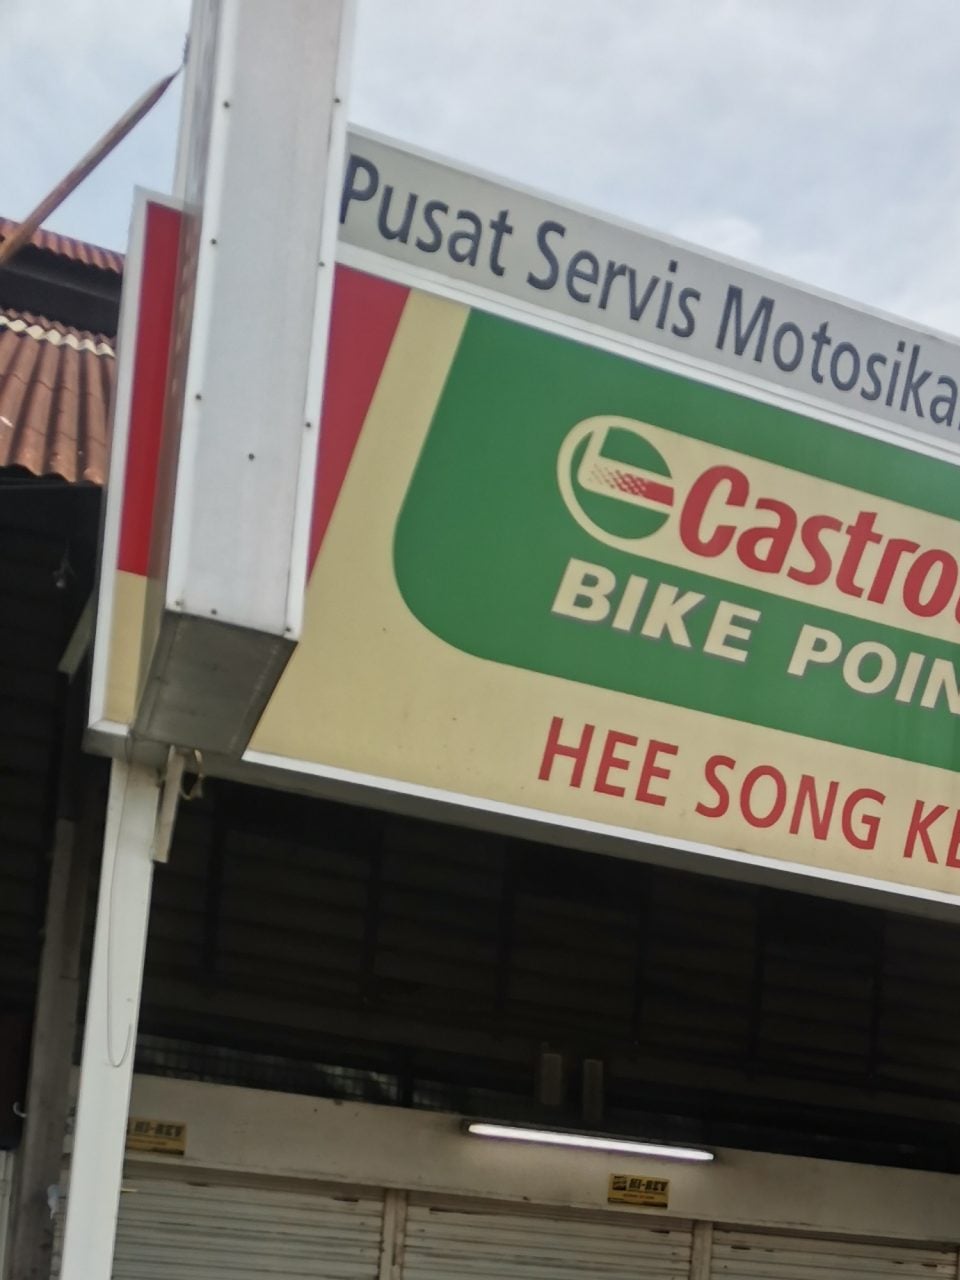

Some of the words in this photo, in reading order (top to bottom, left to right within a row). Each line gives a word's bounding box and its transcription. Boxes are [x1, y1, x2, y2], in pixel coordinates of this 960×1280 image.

[339, 154, 513, 277] Pusat
[527, 219, 701, 339] Servis
[550, 558, 762, 662] BIKE
[537, 716, 680, 806] HEE
[695, 754, 887, 851] SONG
